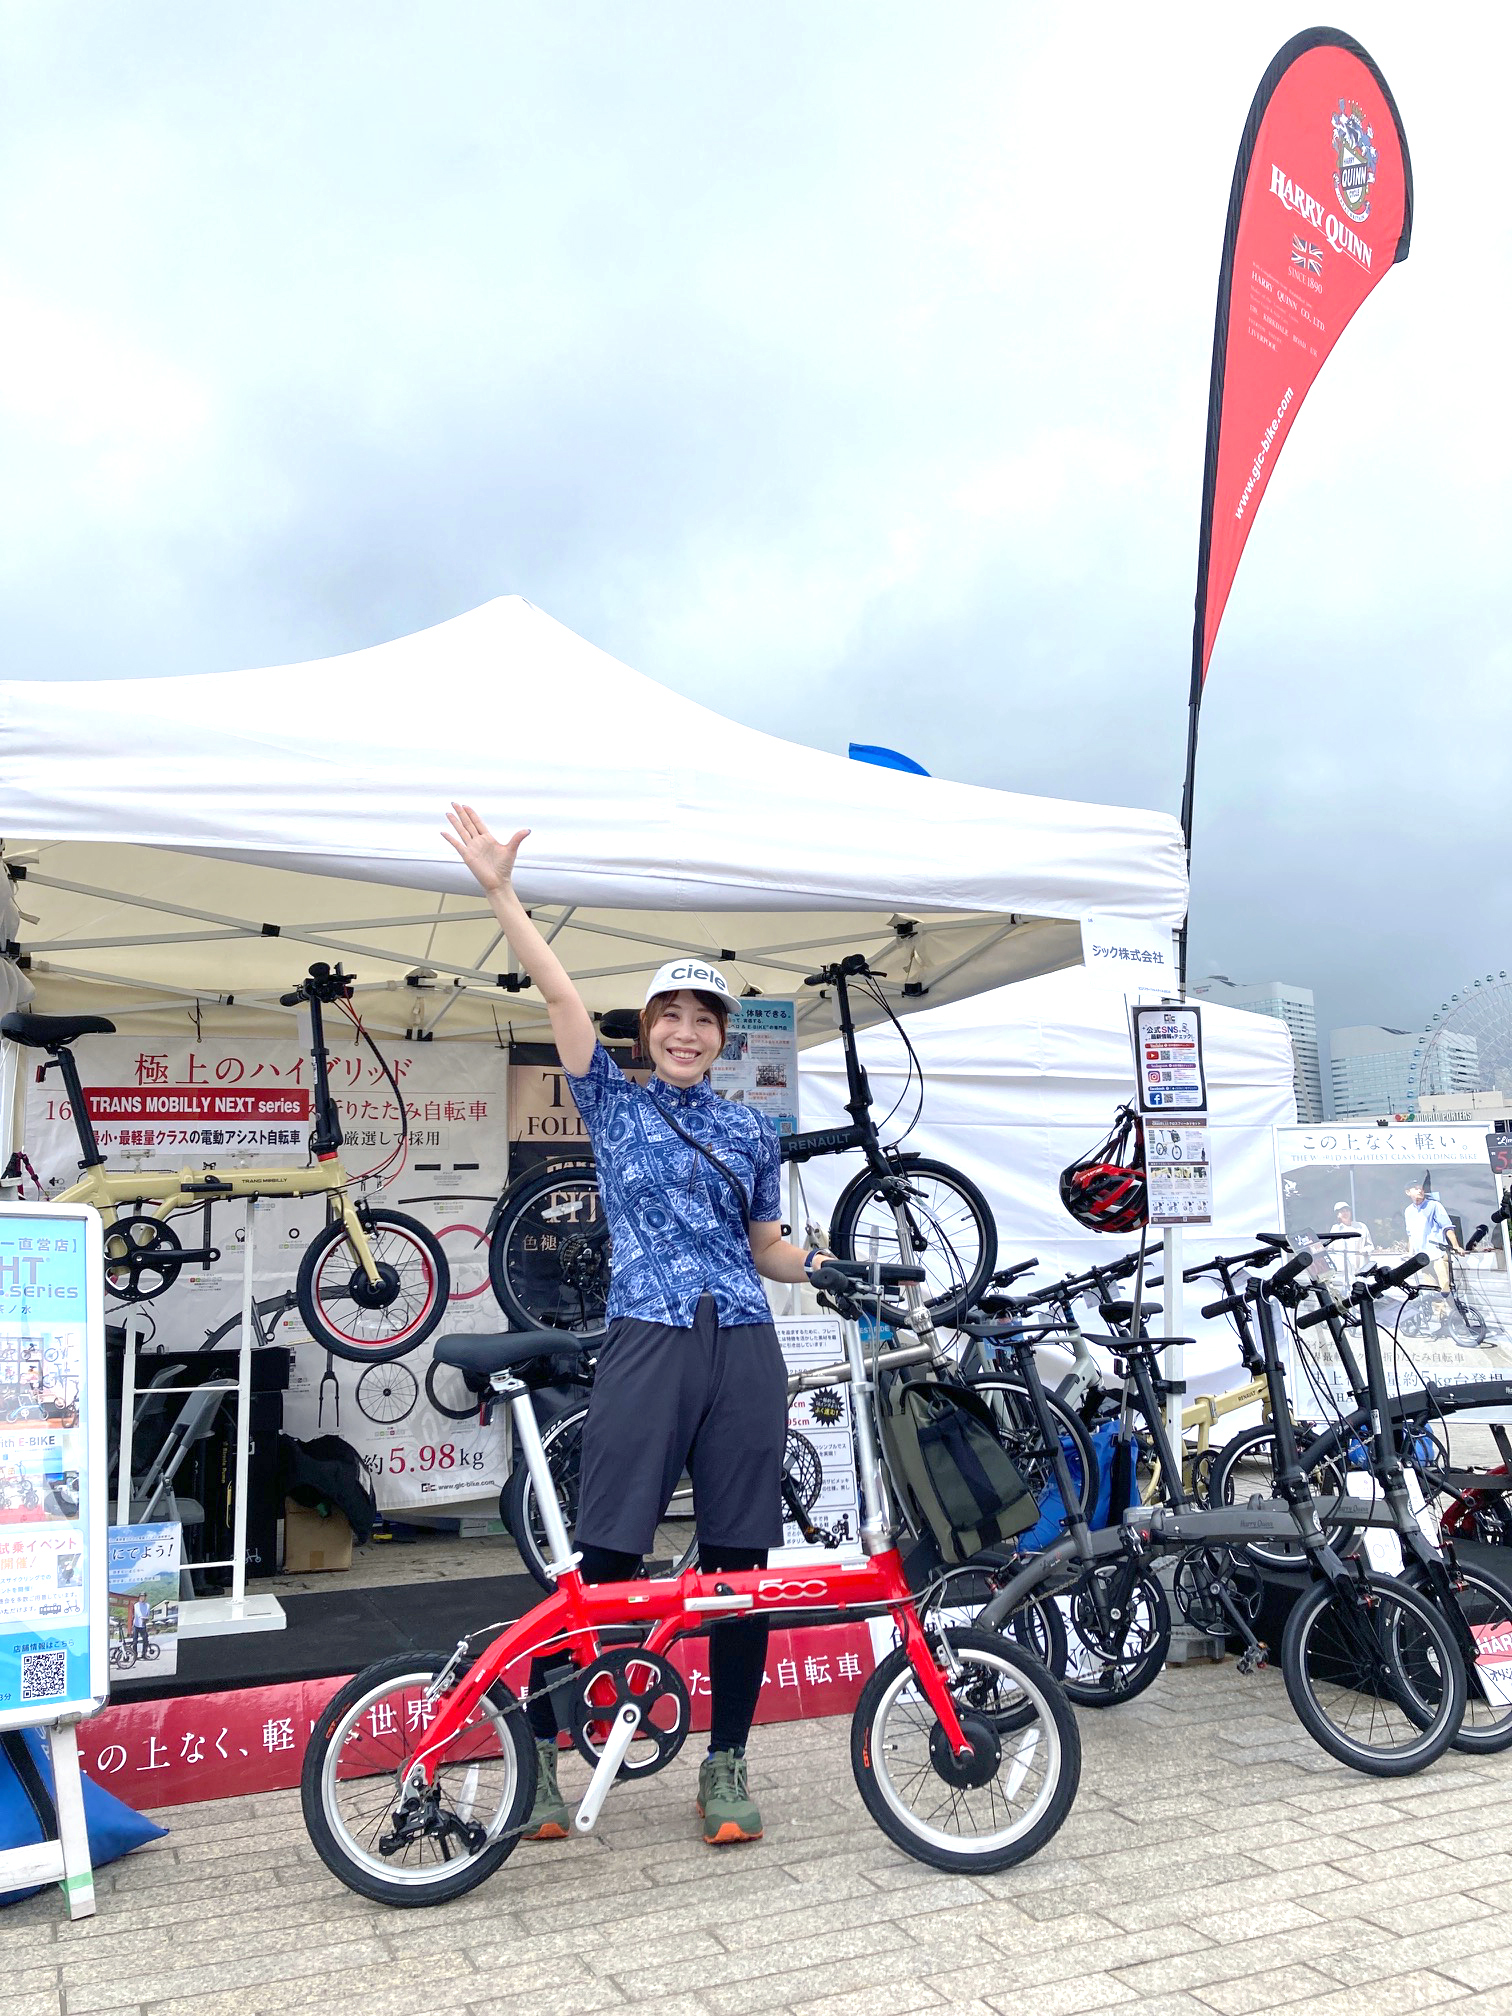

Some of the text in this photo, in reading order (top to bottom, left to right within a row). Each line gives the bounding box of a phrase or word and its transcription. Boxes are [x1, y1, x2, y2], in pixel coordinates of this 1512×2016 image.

[1341, 165, 1367, 188] QUINN
[1269, 163, 1373, 270] HARRY QUINN
[1252, 270, 1273, 292] HARRY
[1277, 290, 1298, 310] QUINN
[1288, 266, 1323, 294] SINCE 1890
[1235, 387, 1294, 520] www.gic-bike.com
[1092, 944, 1164, 965] ジック株式会社
[671, 964, 726, 992] ciele
[90, 1096, 301, 1114] TRANS MOBILLY NEXT series
[1442, 1110, 1472, 1121] PORTERS
[788, 1133, 851, 1152] RENAULT
[1303, 1132, 1468, 1151] この上なく、軽い。
[1291, 1154, 1307, 1162] THE
[1417, 1153, 1457, 1161] FOLDING
[18, 1435, 56, 1448] E-BIKE
[438, 1480, 495, 1491] www.gic-bike.com
[758, 1578, 829, 1601] 500
[13, 1639, 75, 1653] 店舗情報はこちら
